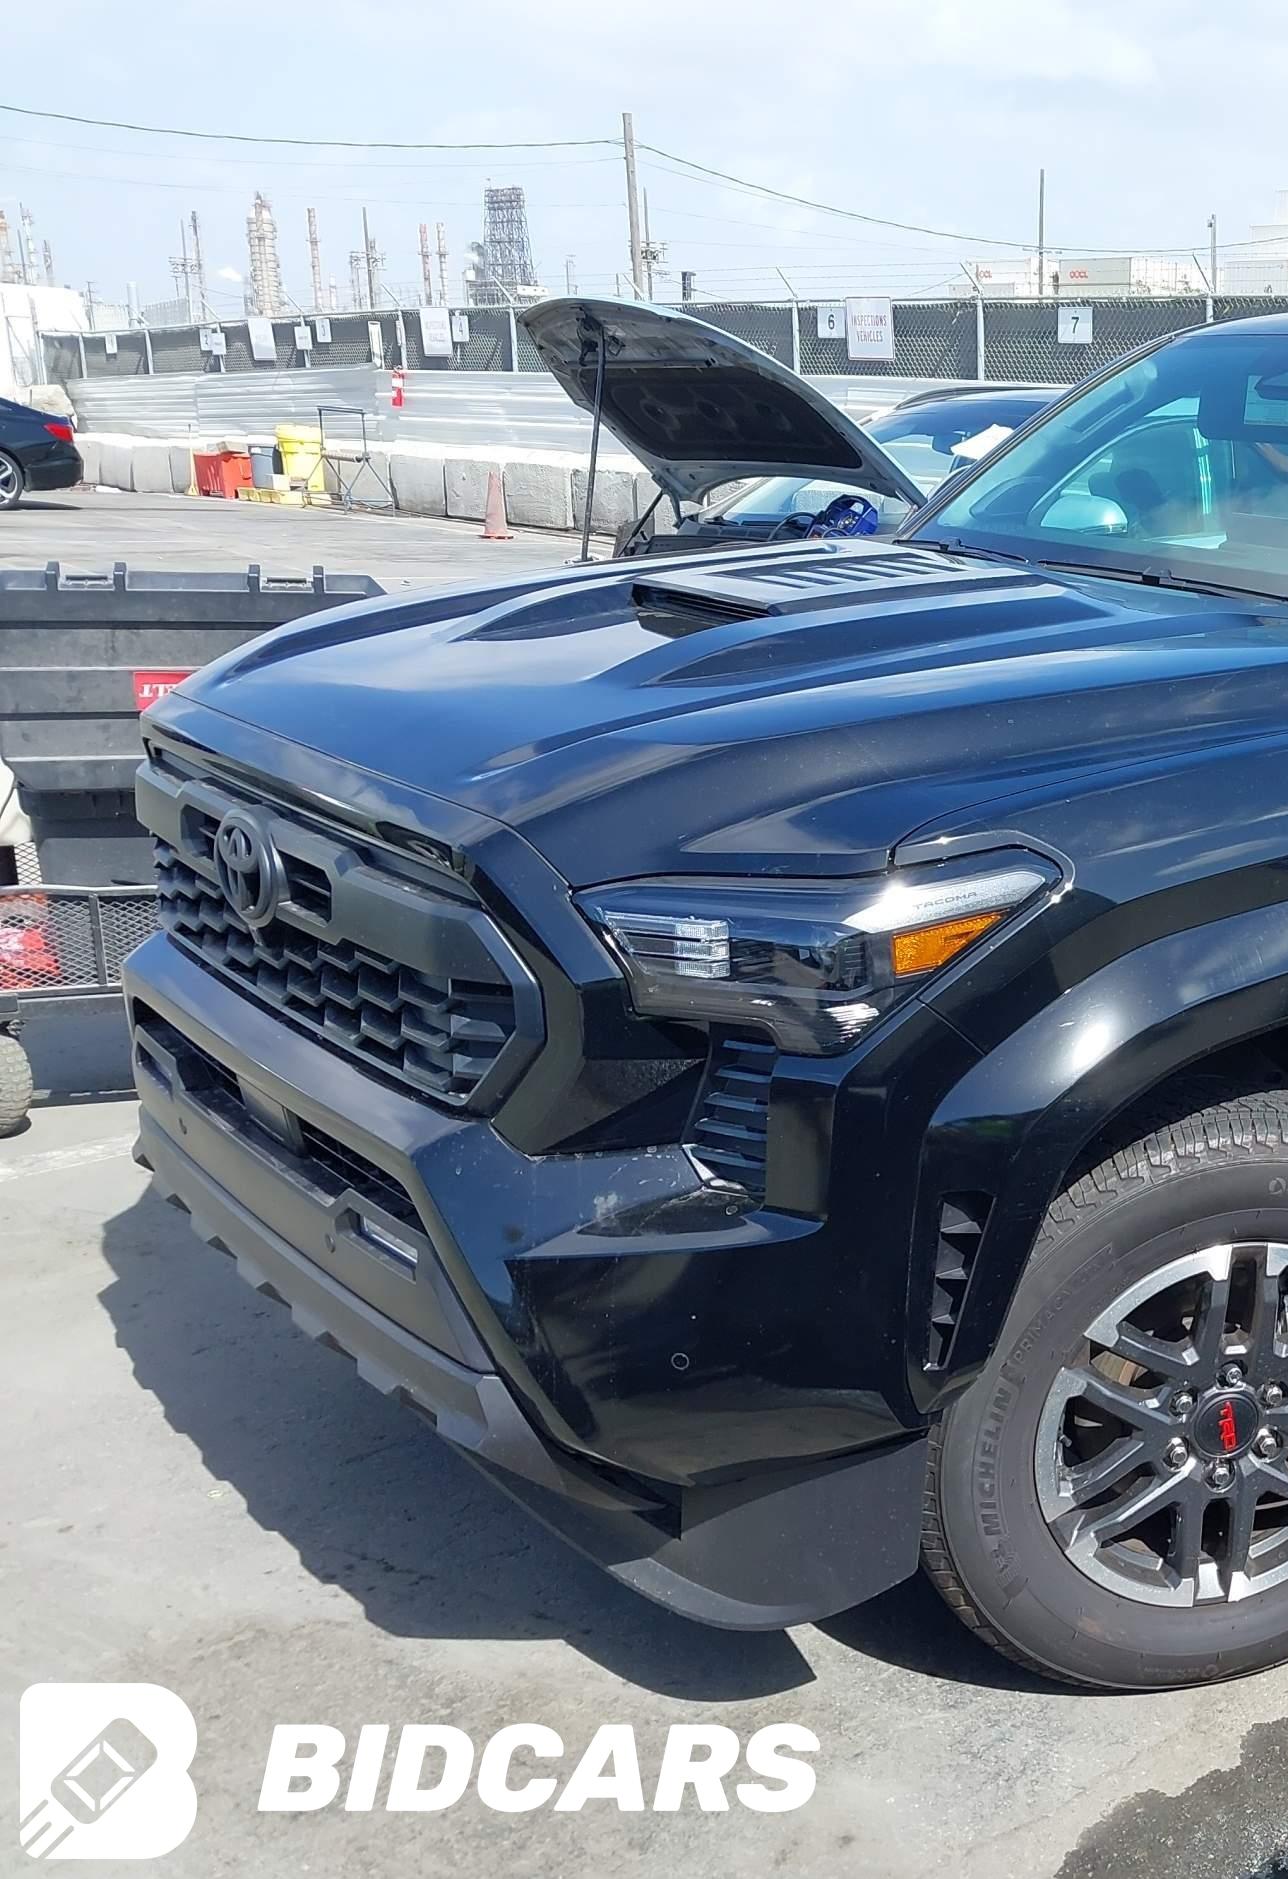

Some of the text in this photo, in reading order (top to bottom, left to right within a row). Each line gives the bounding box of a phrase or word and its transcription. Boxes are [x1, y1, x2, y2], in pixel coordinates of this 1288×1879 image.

[827, 314, 835, 330] 6
[1071, 316, 1080, 334] 7
[912, 891, 977, 910] TACOMA
[1218, 1401, 1237, 1451] TRD
[979, 1387, 1012, 1536] MICHELIN
